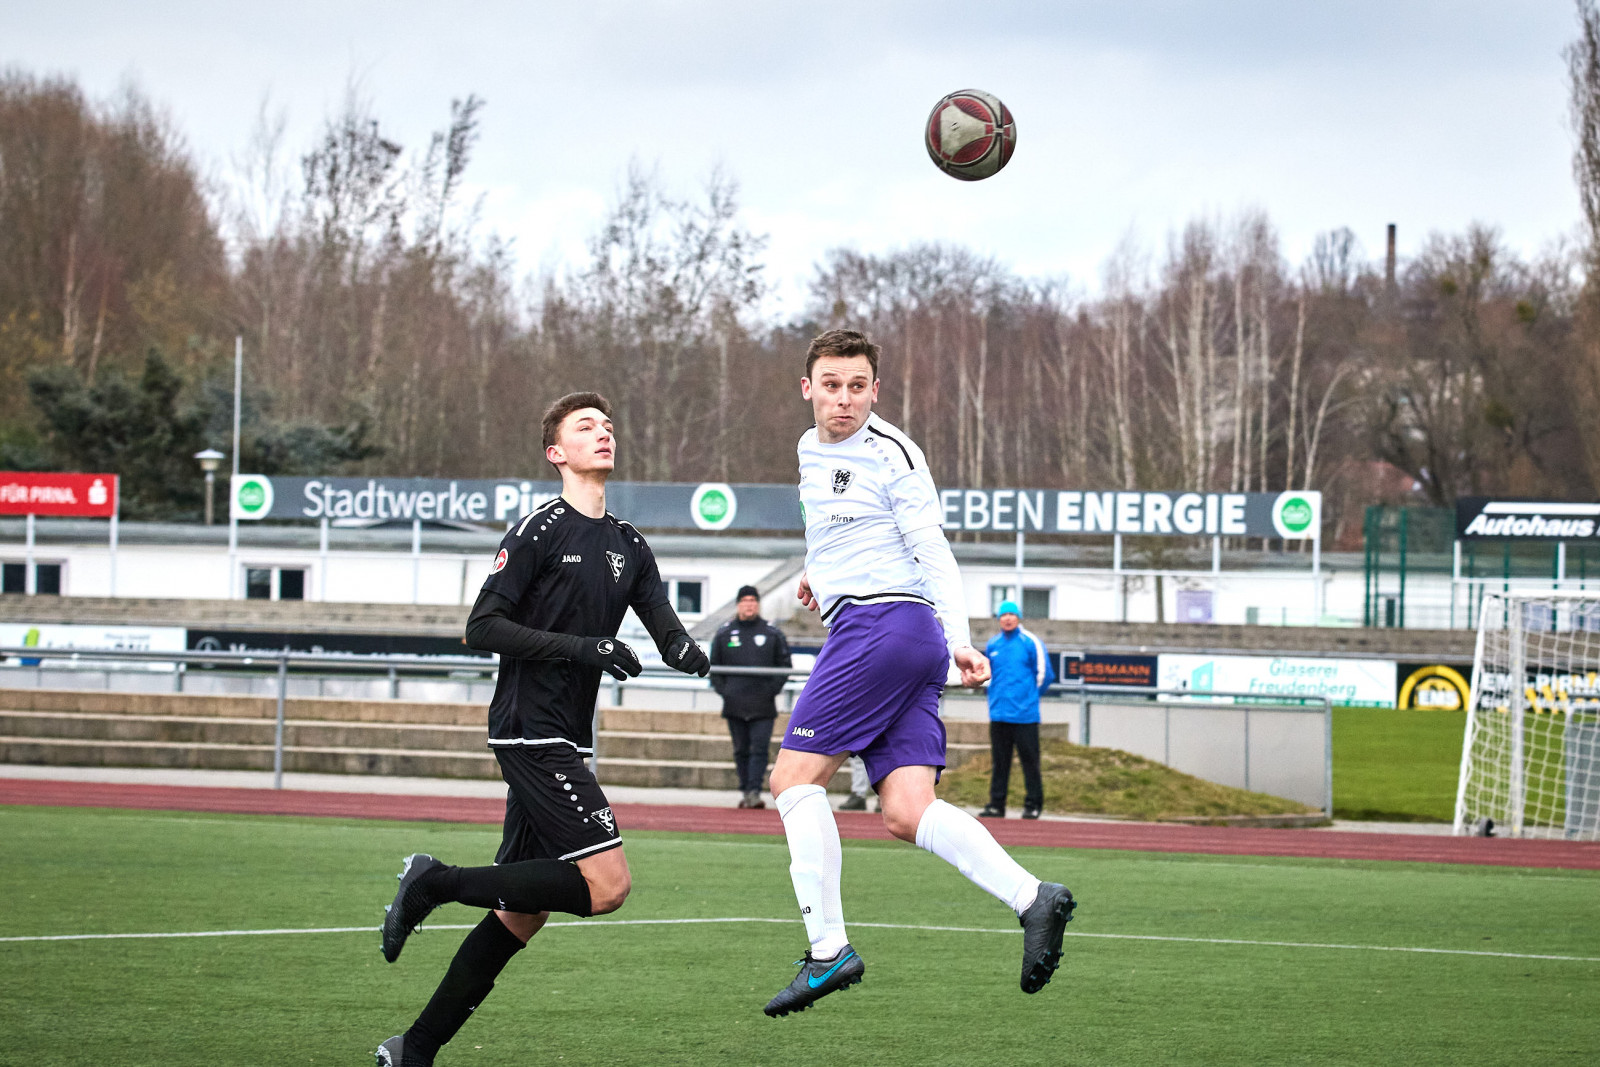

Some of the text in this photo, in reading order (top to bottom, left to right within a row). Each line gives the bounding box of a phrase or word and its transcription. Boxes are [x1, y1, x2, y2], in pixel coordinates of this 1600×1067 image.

[302, 479, 487, 520] Stadtwerke
[831, 514, 854, 523] Pirna
[1057, 491, 1247, 534] ENERGIE
[1464, 513, 1595, 537] Autohaus
[562, 555, 582, 563] JAKO
[1269, 658, 1338, 678] Glaserei
[1249, 677, 1357, 697] Freudenberg
[792, 726, 815, 738] JAKO
